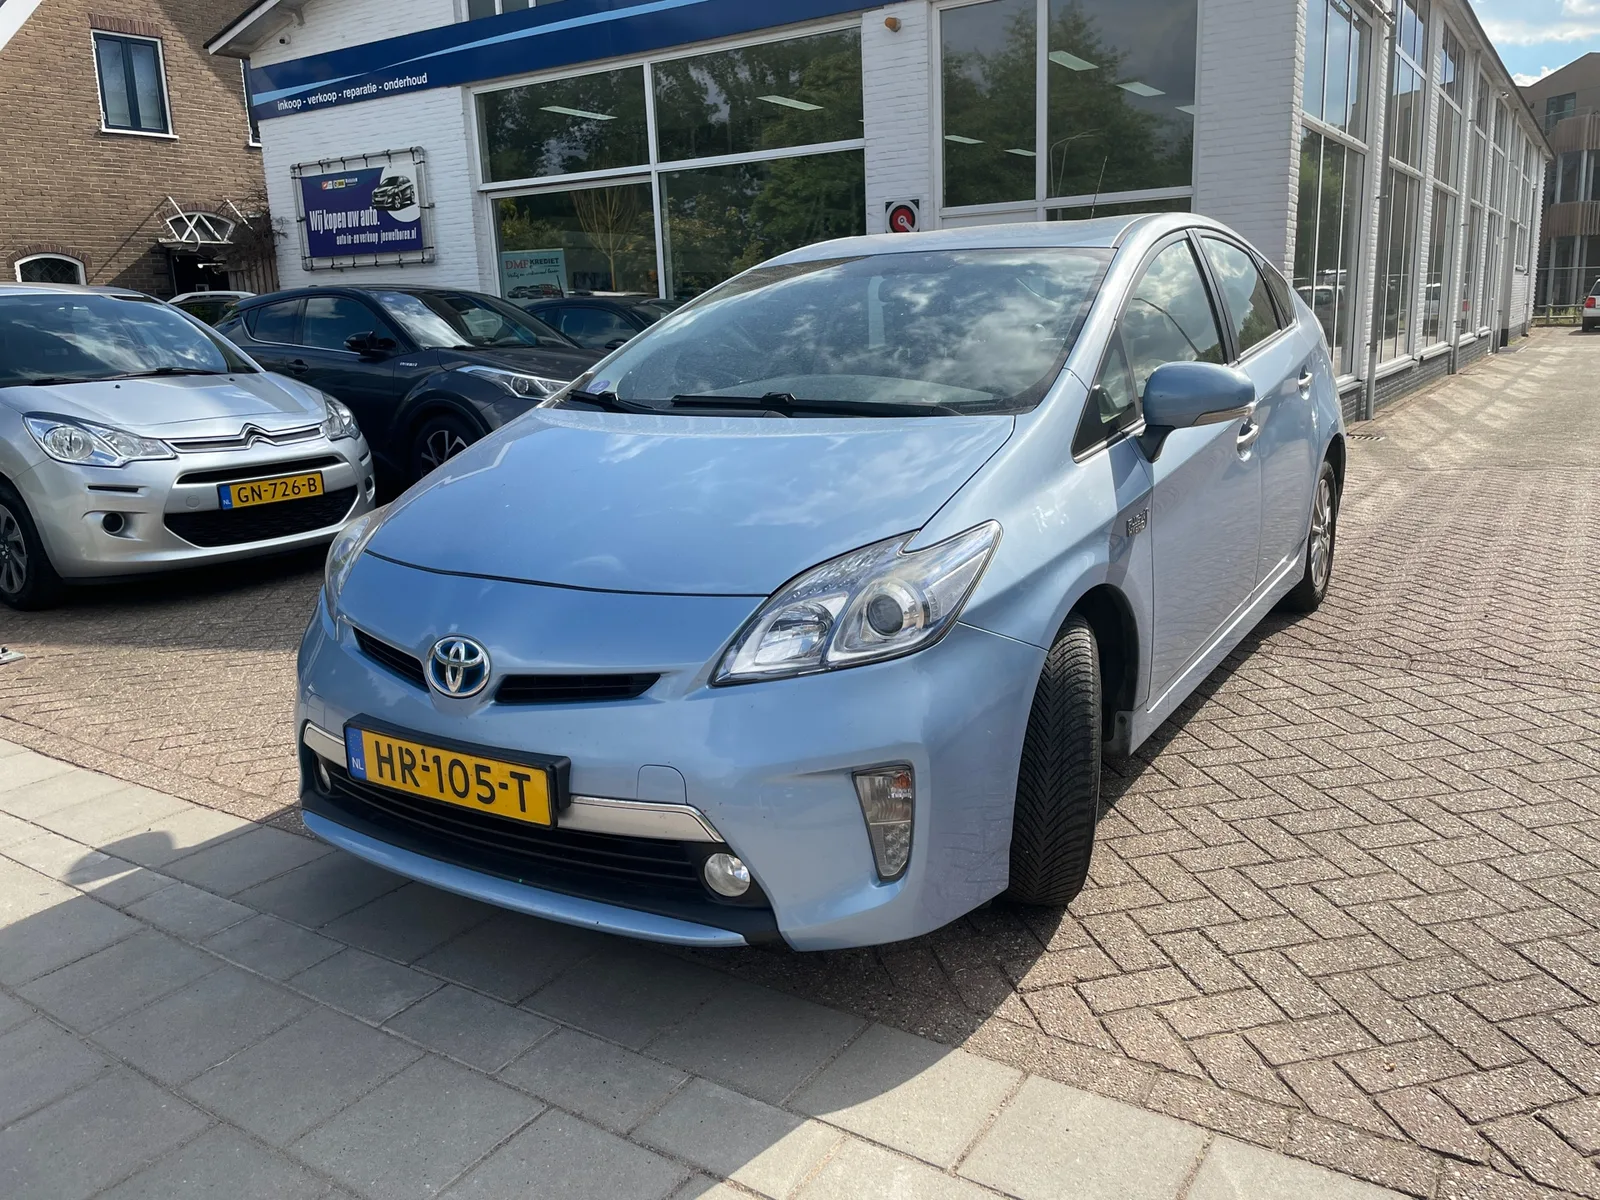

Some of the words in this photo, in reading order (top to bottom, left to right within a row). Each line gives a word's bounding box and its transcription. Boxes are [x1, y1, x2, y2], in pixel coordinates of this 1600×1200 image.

[277, 98, 302, 111] inkoop
[307, 91, 337, 105] verkoop
[343, 82, 377, 99] reparatie
[383, 73, 428, 91] onderhoud
[309, 209, 323, 234] Wij
[323, 209, 347, 234] kopen
[347, 210, 359, 228] uw
[360, 206, 380, 227] auto.
[505, 259, 528, 270] DMF
[529, 257, 559, 265] KREDIET
[237, 477, 318, 503] GN-726-B
[351, 756, 364, 771] NL
